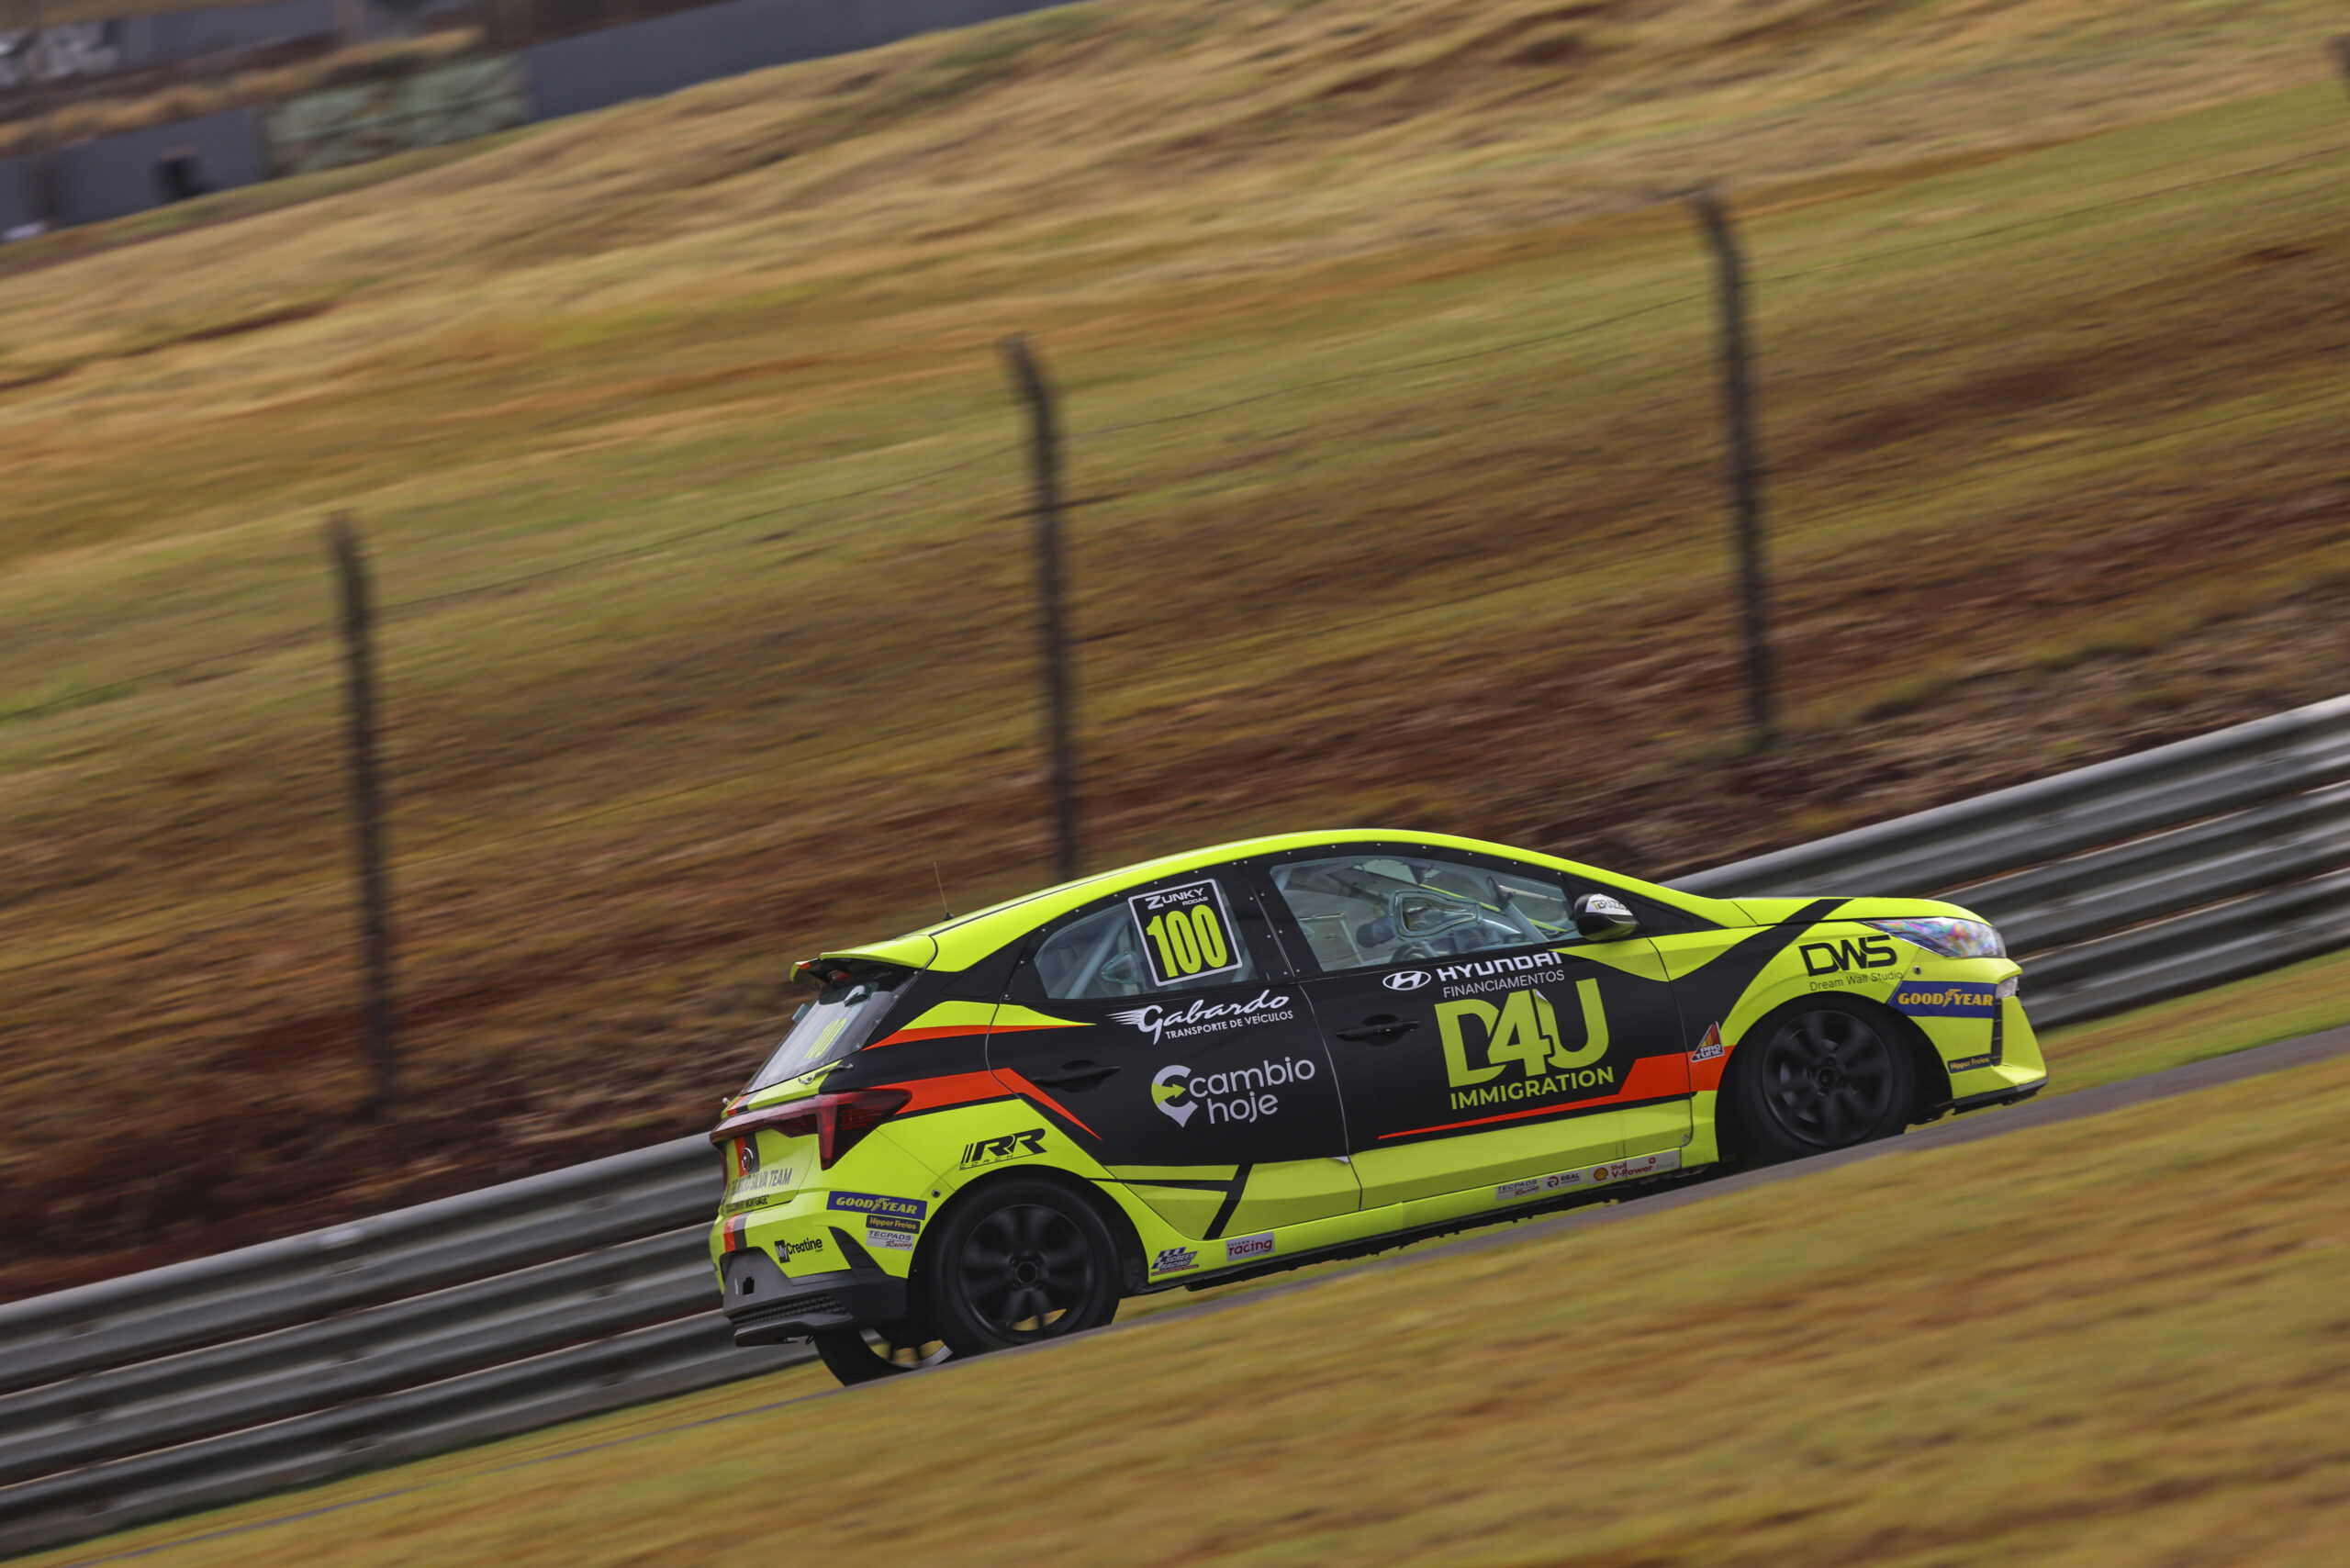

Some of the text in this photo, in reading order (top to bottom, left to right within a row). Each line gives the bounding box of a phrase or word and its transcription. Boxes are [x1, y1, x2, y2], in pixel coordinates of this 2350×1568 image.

[1145, 887, 1204, 910] ZUNKY
[1182, 896, 1209, 906] RODAS
[1146, 904, 1228, 978] 100
[1436, 951, 1563, 981] HYUNDAI
[1798, 935, 1897, 977] DWS
[1442, 969, 1565, 999] FINANCIAMENTOS
[1809, 971, 1905, 991] Dream Wall Studio
[1136, 989, 1290, 1045] Gabardo
[1165, 1010, 1294, 1040] TRANSPORTE DE VEÍCULOS
[1434, 978, 1610, 1088] D4U
[1700, 1044, 1721, 1053] PRO
[1189, 1057, 1316, 1098] cambio
[1450, 1066, 1614, 1110] IMMIGRATION
[1207, 1091, 1279, 1124] hoje
[1610, 1162, 1628, 1170] Shell
[1611, 1166, 1653, 1179] V-Power
[768, 1168, 793, 1188] TEAM
[1497, 1179, 1538, 1193] TECPADS
[1561, 1173, 1580, 1182] REAL
[869, 1217, 917, 1230] Hipper Freios
[868, 1229, 912, 1241] TECPADS
[1228, 1238, 1273, 1256] racing
[1160, 1259, 1192, 1270] RACING
[1165, 1252, 1196, 1263] SCREEN
